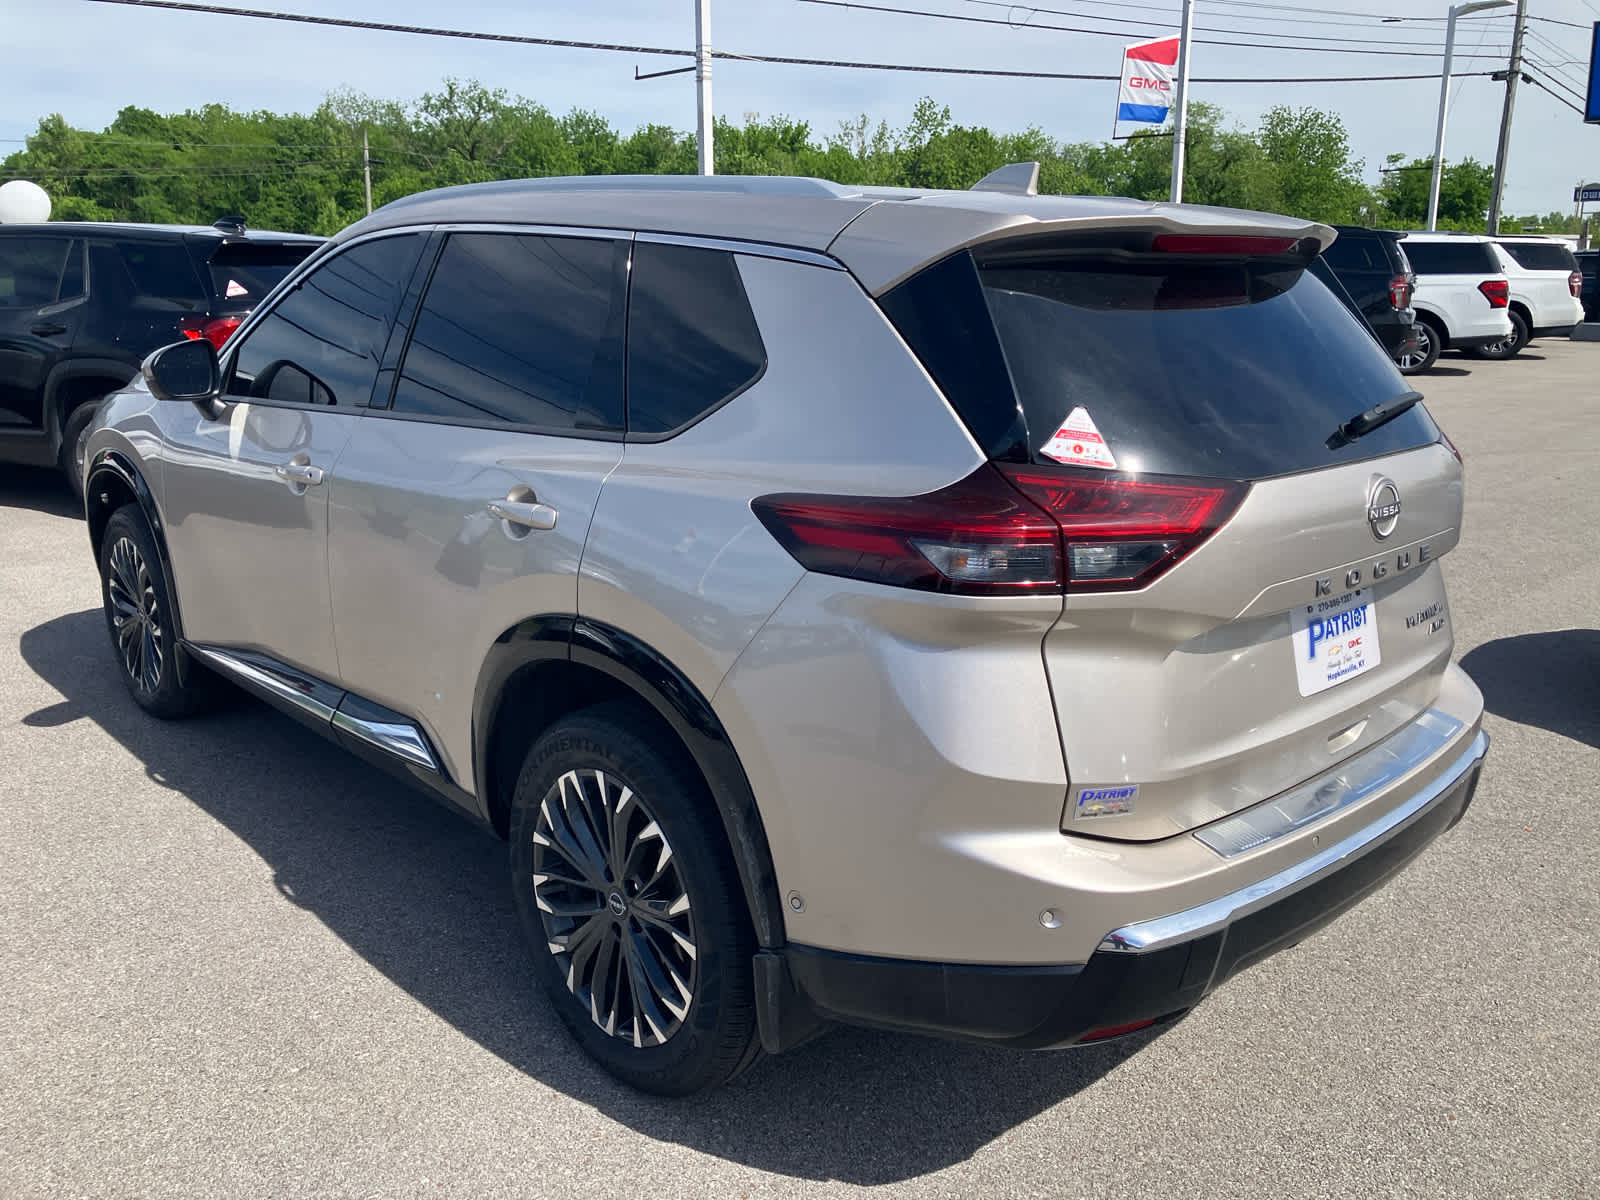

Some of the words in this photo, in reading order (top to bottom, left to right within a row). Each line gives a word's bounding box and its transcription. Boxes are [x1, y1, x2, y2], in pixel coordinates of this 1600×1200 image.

[1129, 77, 1171, 91] GMC
[1370, 503, 1400, 518] NISSA
[1315, 544, 1432, 597] ROGUE
[1308, 604, 1368, 659] PATRIOT
[1078, 786, 1137, 806] PATRIOT
